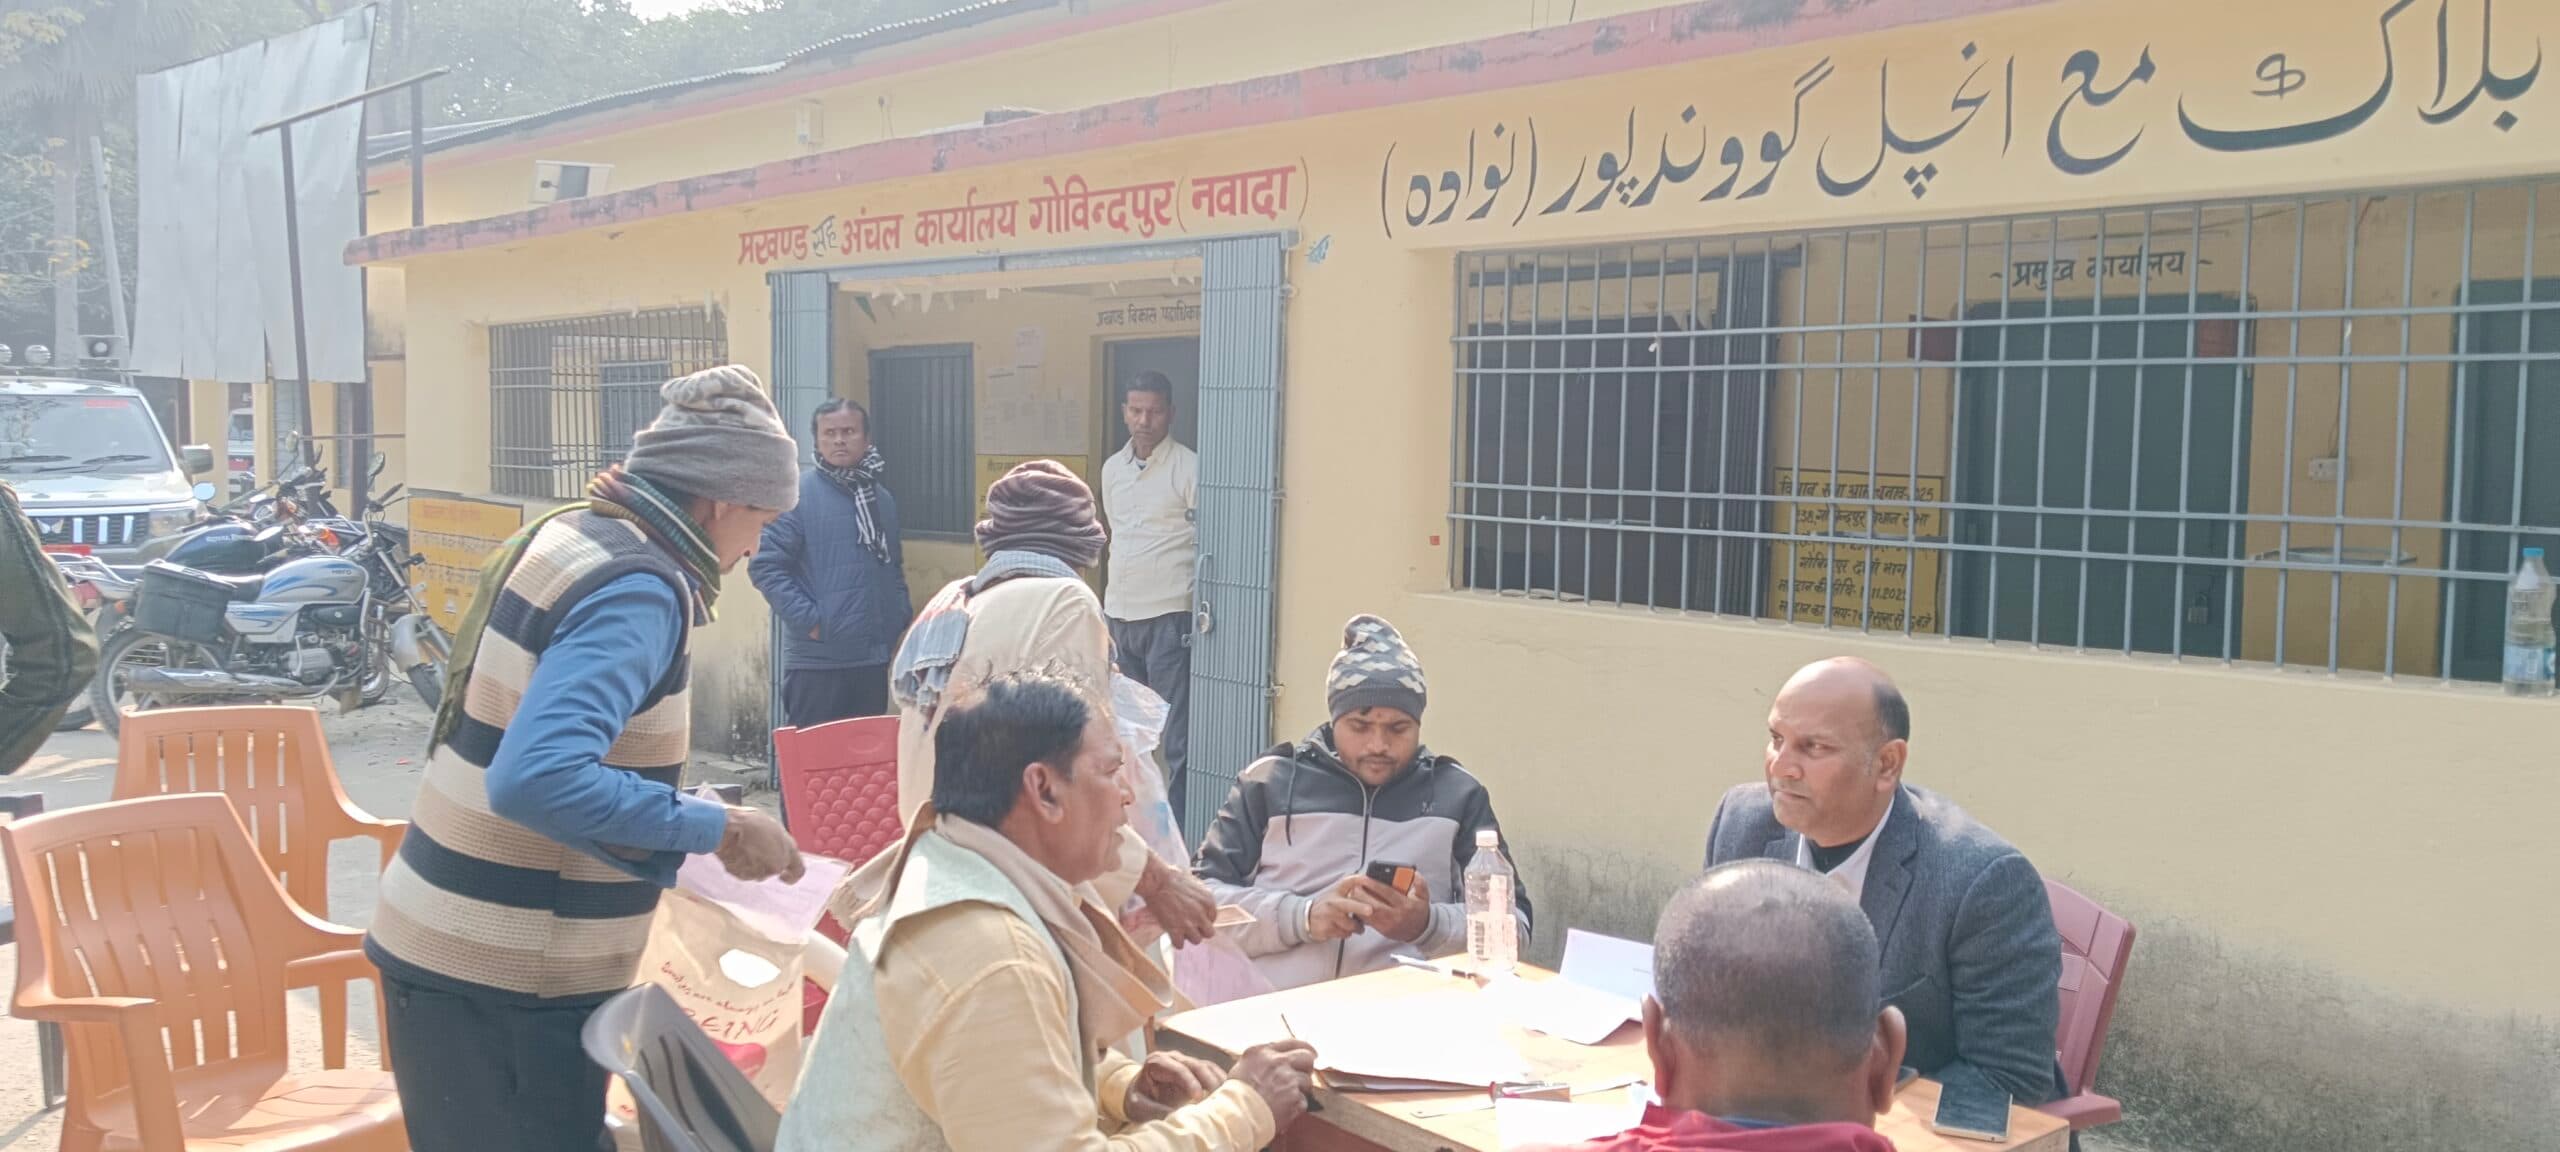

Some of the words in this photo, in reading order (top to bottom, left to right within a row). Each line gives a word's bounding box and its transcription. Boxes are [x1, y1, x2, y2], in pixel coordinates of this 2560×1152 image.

[1538, 57, 1835, 216] گووندپور
[1816, 41, 2014, 199] انچل
[2046, 42, 2157, 176] مع
[738, 225, 809, 264] प्रखण्ड
[840, 206, 904, 256] अंचल
[914, 187, 1019, 247] कार्यालय
[1029, 174, 1176, 238] गोविन्दपुर
[2012, 259, 2076, 290] प्रमुख
[1159, 299, 1201, 321] पदाधिका
